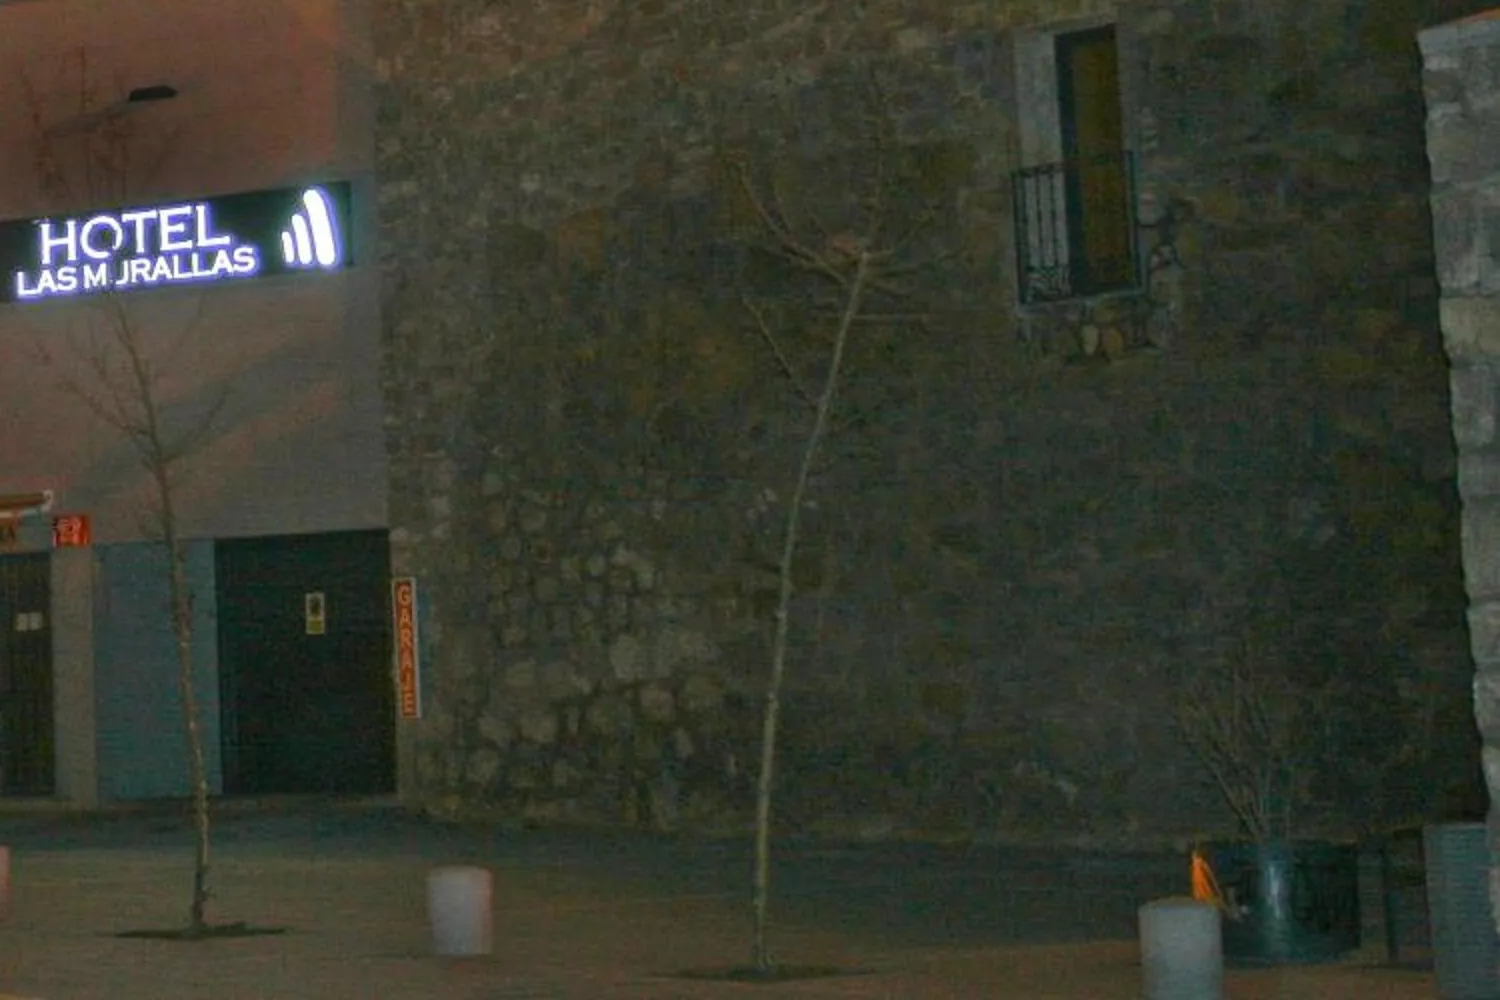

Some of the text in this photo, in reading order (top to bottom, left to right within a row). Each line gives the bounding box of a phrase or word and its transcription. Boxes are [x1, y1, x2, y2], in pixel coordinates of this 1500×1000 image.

[40, 204, 232, 265] HOTEL
[16, 269, 77, 297] LAS
[397, 585, 415, 712] GARAJE
